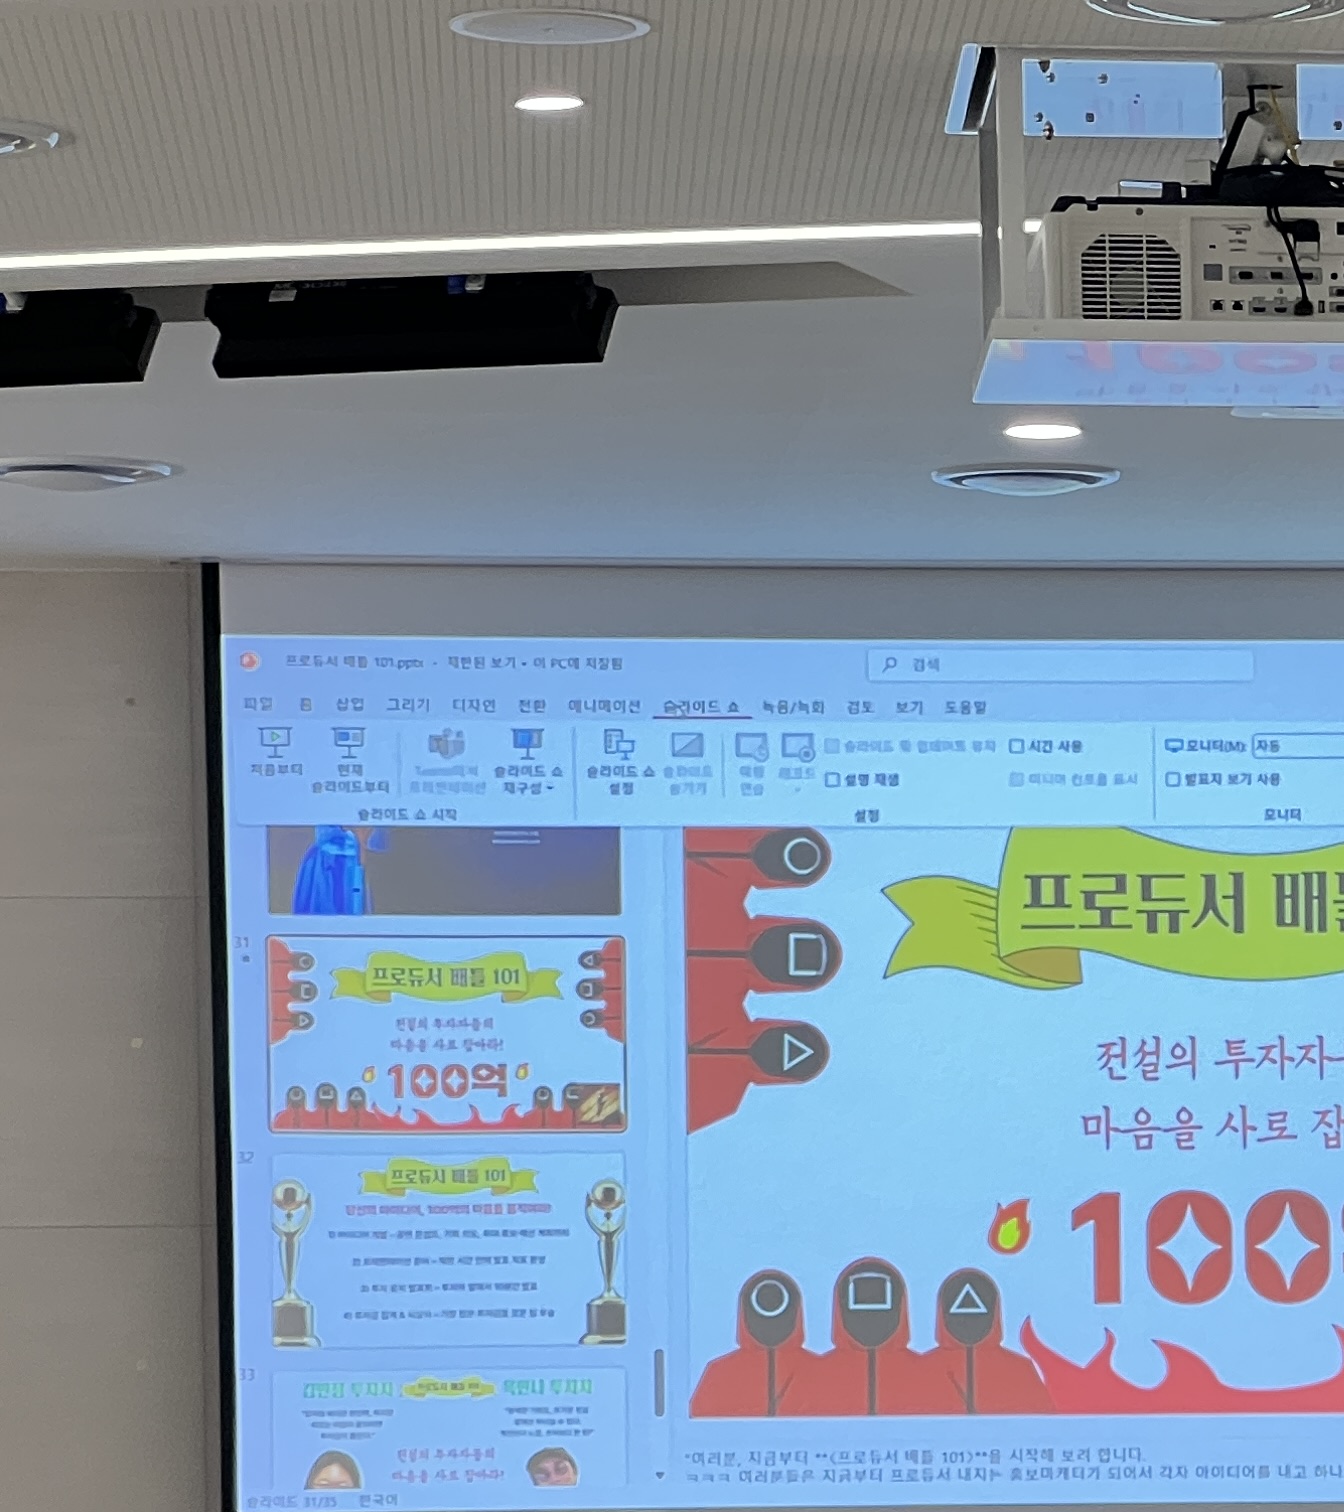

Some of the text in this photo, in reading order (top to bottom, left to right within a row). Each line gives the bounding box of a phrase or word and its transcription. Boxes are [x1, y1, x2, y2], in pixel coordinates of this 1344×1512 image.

[386, 698, 430, 712] 그리기
[452, 698, 496, 713] 디자인
[896, 701, 924, 715] 보기
[1021, 871, 1247, 934] 프로듀서
[372, 966, 520, 987] 프로듀서 배틀 101
[1096, 1034, 1199, 1084] 전설의
[387, 1063, 507, 1099] 100억
[1081, 1104, 1203, 1152] 마음을
[1217, 1104, 1298, 1150] 사로
[391, 1168, 446, 1185] 프로듀서
[484, 1169, 506, 1184] 101
[1160, 1465, 1188, 1480] 각자
